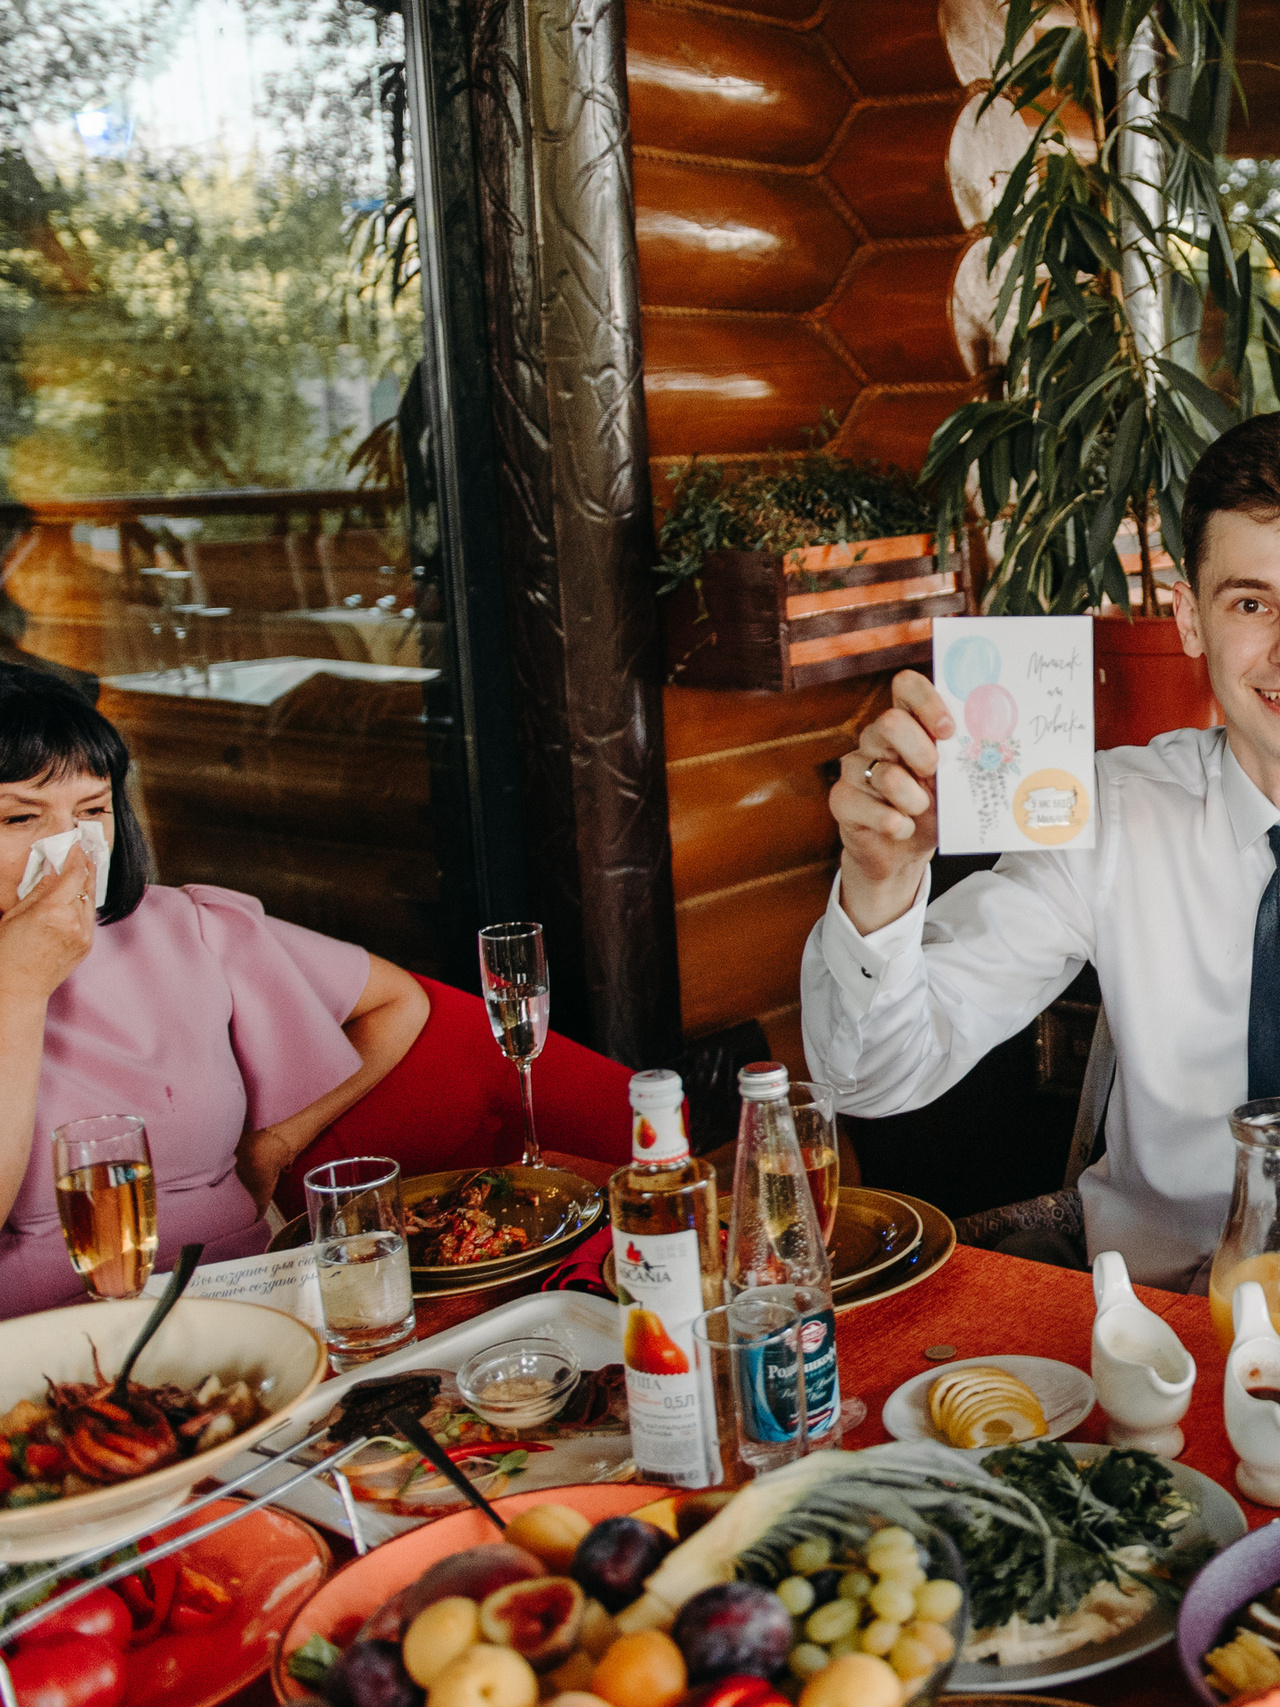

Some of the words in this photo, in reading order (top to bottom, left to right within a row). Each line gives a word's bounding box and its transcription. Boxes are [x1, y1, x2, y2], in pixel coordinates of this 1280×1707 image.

[190, 1275, 212, 1288] Вы
[215, 1265, 268, 1285] созданы
[270, 1259, 295, 1277] для
[249, 1277, 297, 1295] создано
[663, 1394, 695, 1410] 0,5Л
